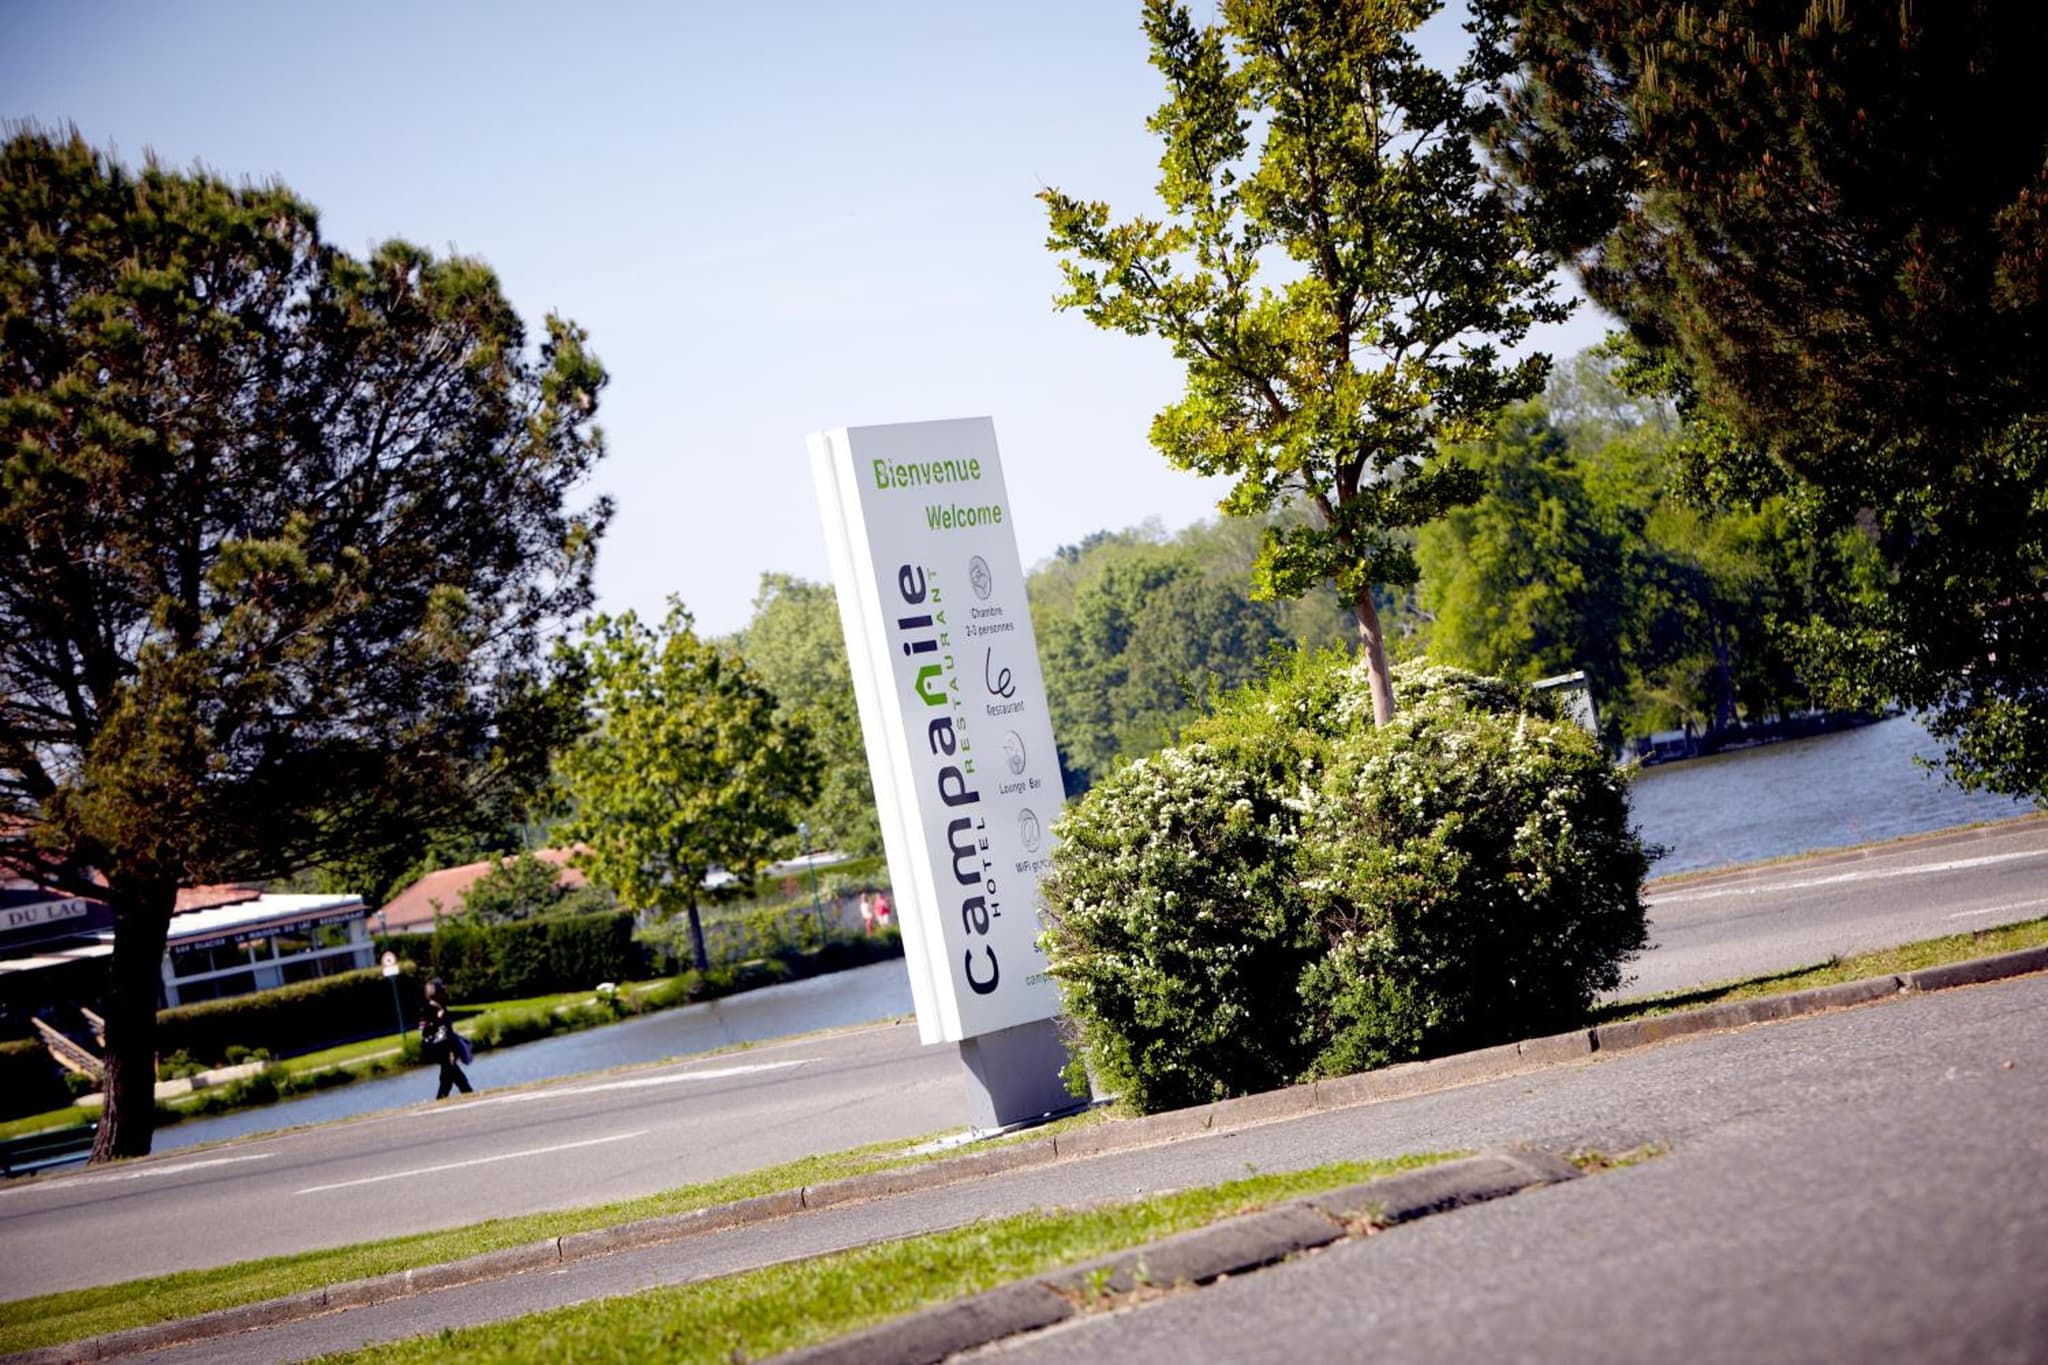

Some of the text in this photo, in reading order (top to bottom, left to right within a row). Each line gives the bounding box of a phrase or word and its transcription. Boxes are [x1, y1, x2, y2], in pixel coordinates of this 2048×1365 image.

[872, 457, 982, 490] Bienvenue
[926, 503, 1003, 531] Welcome
[970, 606, 1003, 620] Chambre
[978, 621, 1015, 638] personnes
[986, 700, 1025, 717] Restaurant
[927, 566, 1002, 918] HOTEL RESTAURANT
[999, 776, 1042, 795] Lounge Bar
[8, 900, 86, 926] DU LAC
